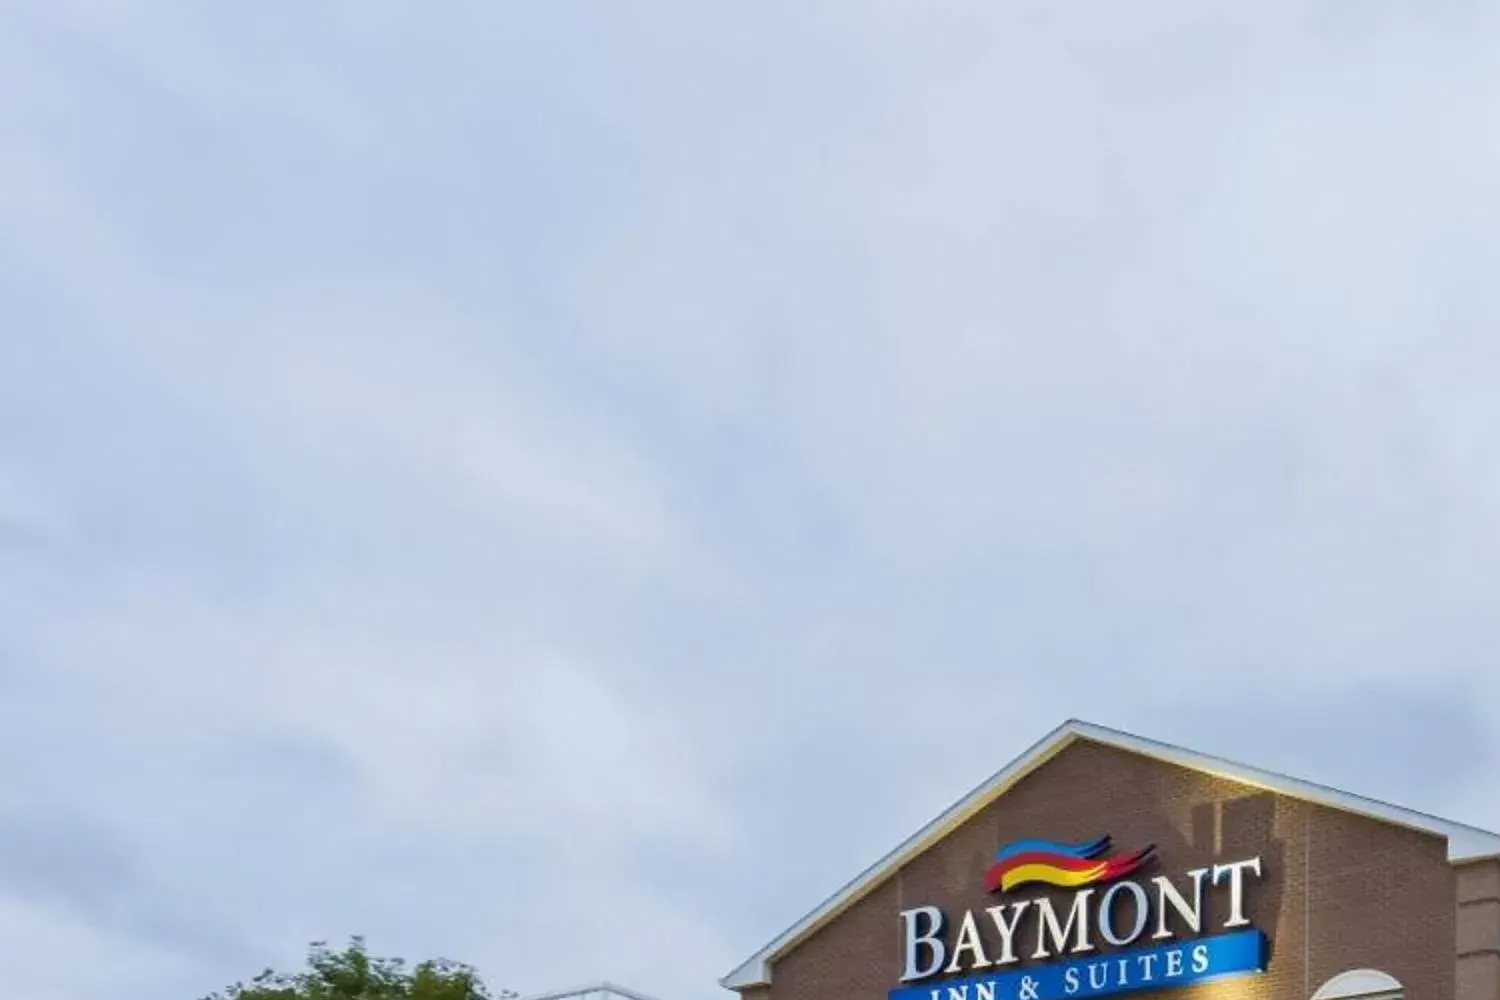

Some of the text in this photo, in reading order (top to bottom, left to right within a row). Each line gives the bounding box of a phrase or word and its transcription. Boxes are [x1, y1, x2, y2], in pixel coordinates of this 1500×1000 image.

[900, 857, 1262, 982] BAYMONT
[1019, 974, 1038, 1000] &
[1064, 944, 1208, 993] SUITES
